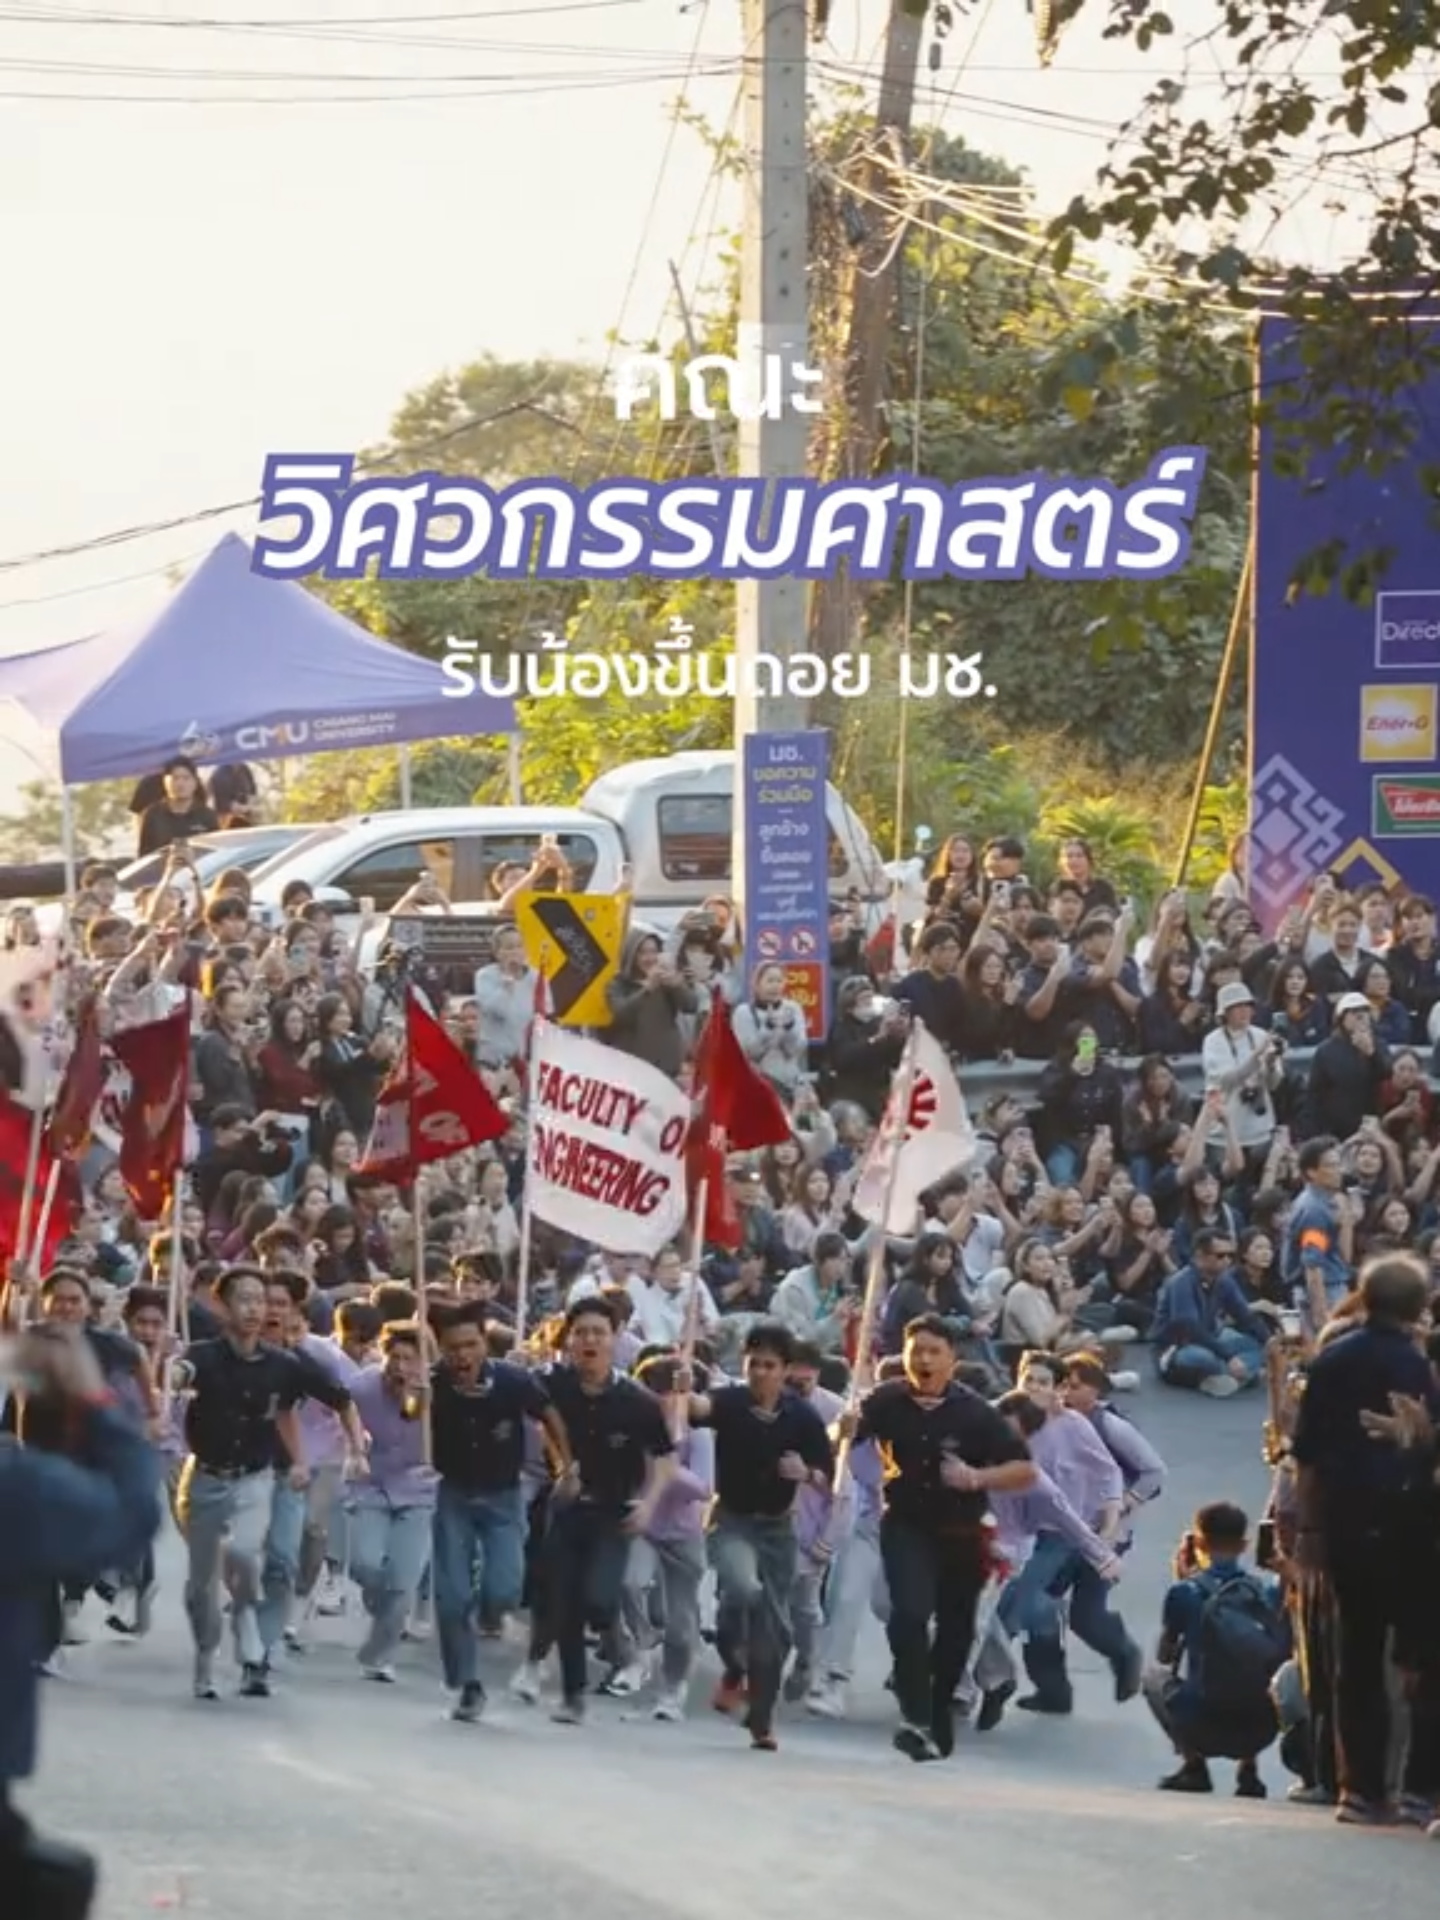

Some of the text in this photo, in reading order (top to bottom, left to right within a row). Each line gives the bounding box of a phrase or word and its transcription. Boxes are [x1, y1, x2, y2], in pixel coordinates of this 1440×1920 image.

[235, 720, 308, 750] CMU
[313, 723, 396, 741] UNIVERSITY
[537, 1058, 650, 1136] FACULTY
